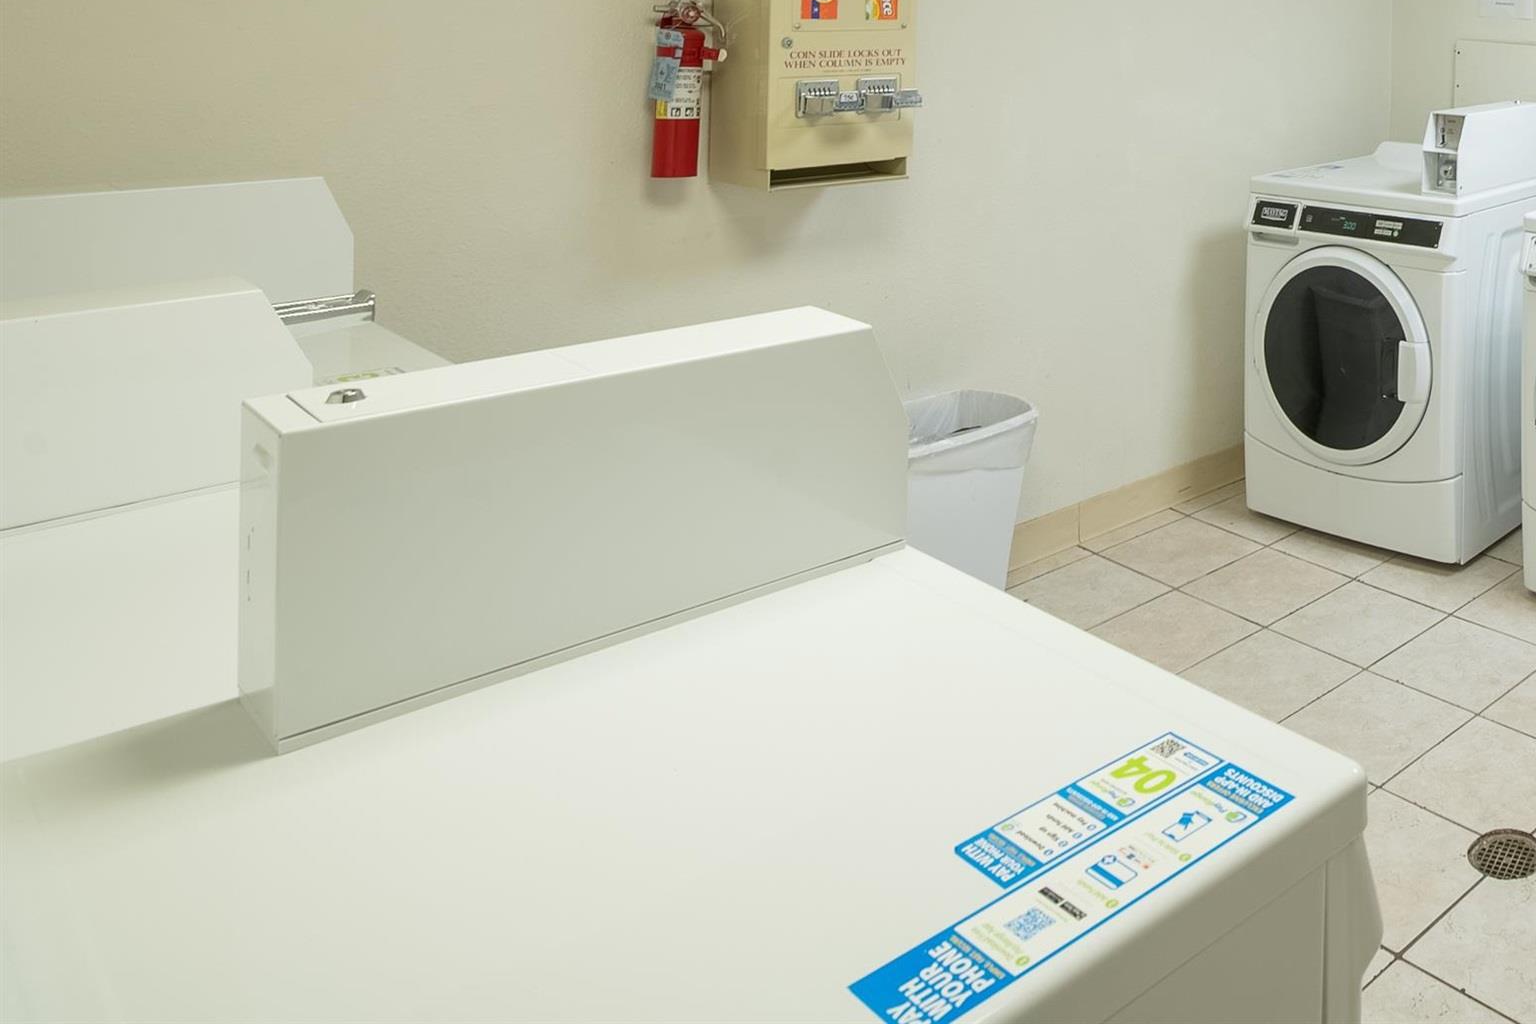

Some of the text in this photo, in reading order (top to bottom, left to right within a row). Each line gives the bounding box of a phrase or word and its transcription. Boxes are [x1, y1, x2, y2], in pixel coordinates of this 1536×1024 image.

[784, 57, 906, 69] WHEN COLUMN IS EMPTY
[789, 48, 902, 59] COIN SLIDE LOCKS OUT
[1110, 755, 1176, 794] 04
[1224, 768, 1285, 803] DISCOUNTS
[1214, 775, 1274, 810] AND IN-APP
[961, 843, 995, 870] WITH
[988, 861, 1016, 883] PAY
[927, 940, 996, 994] PHONE
[897, 977, 953, 1022] WITH
[919, 962, 973, 1008] YOUR
